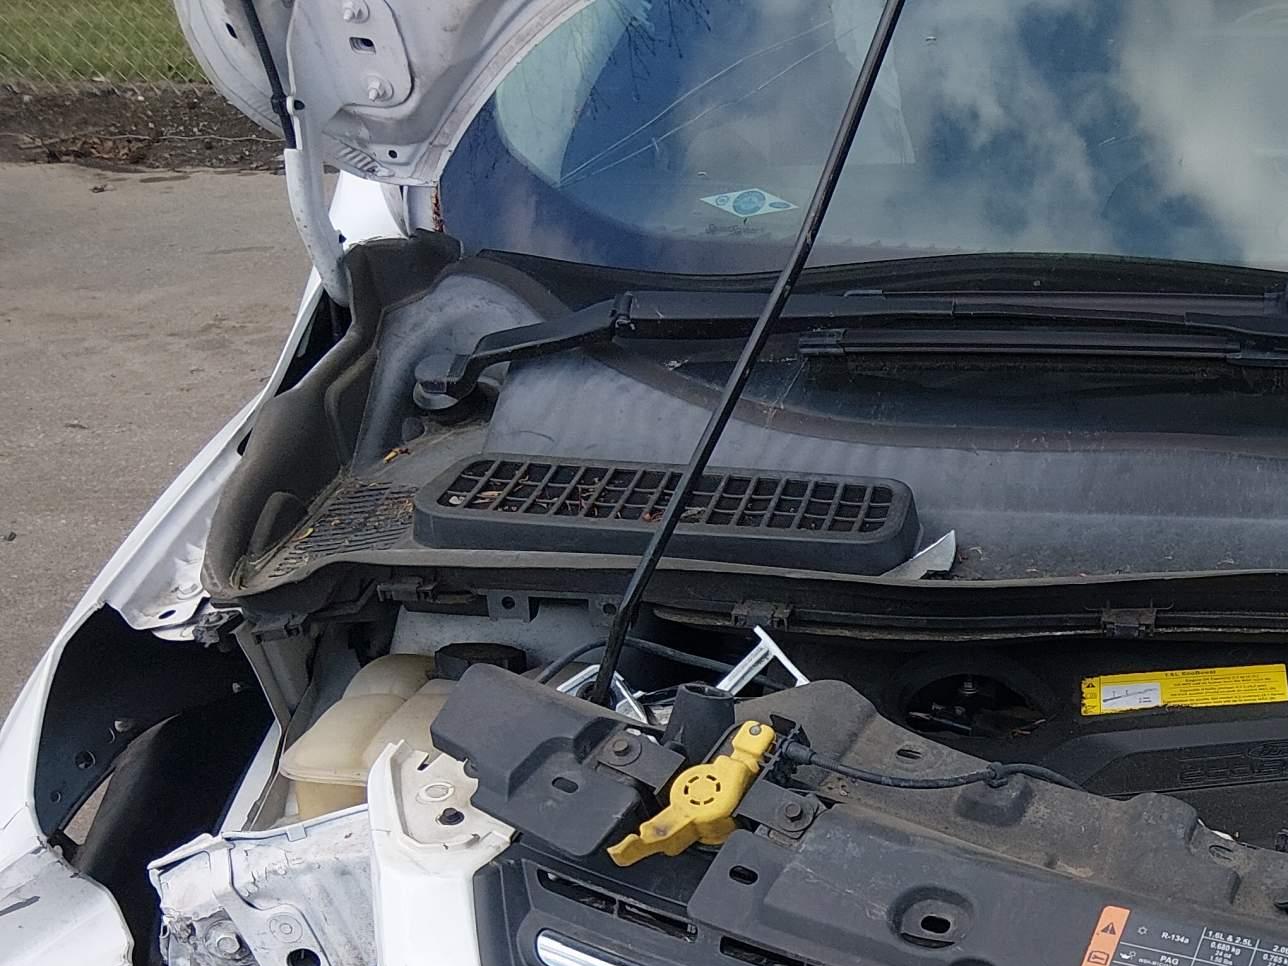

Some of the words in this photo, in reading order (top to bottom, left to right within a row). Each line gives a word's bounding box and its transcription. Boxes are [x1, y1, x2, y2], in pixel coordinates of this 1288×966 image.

[1161, 931, 1190, 944] R-134a
[1207, 930, 1225, 941] 1.6L
[1235, 937, 1253, 947] 2.5L
[1231, 945, 1241, 956] kg
[1159, 954, 1179, 966] PAG
